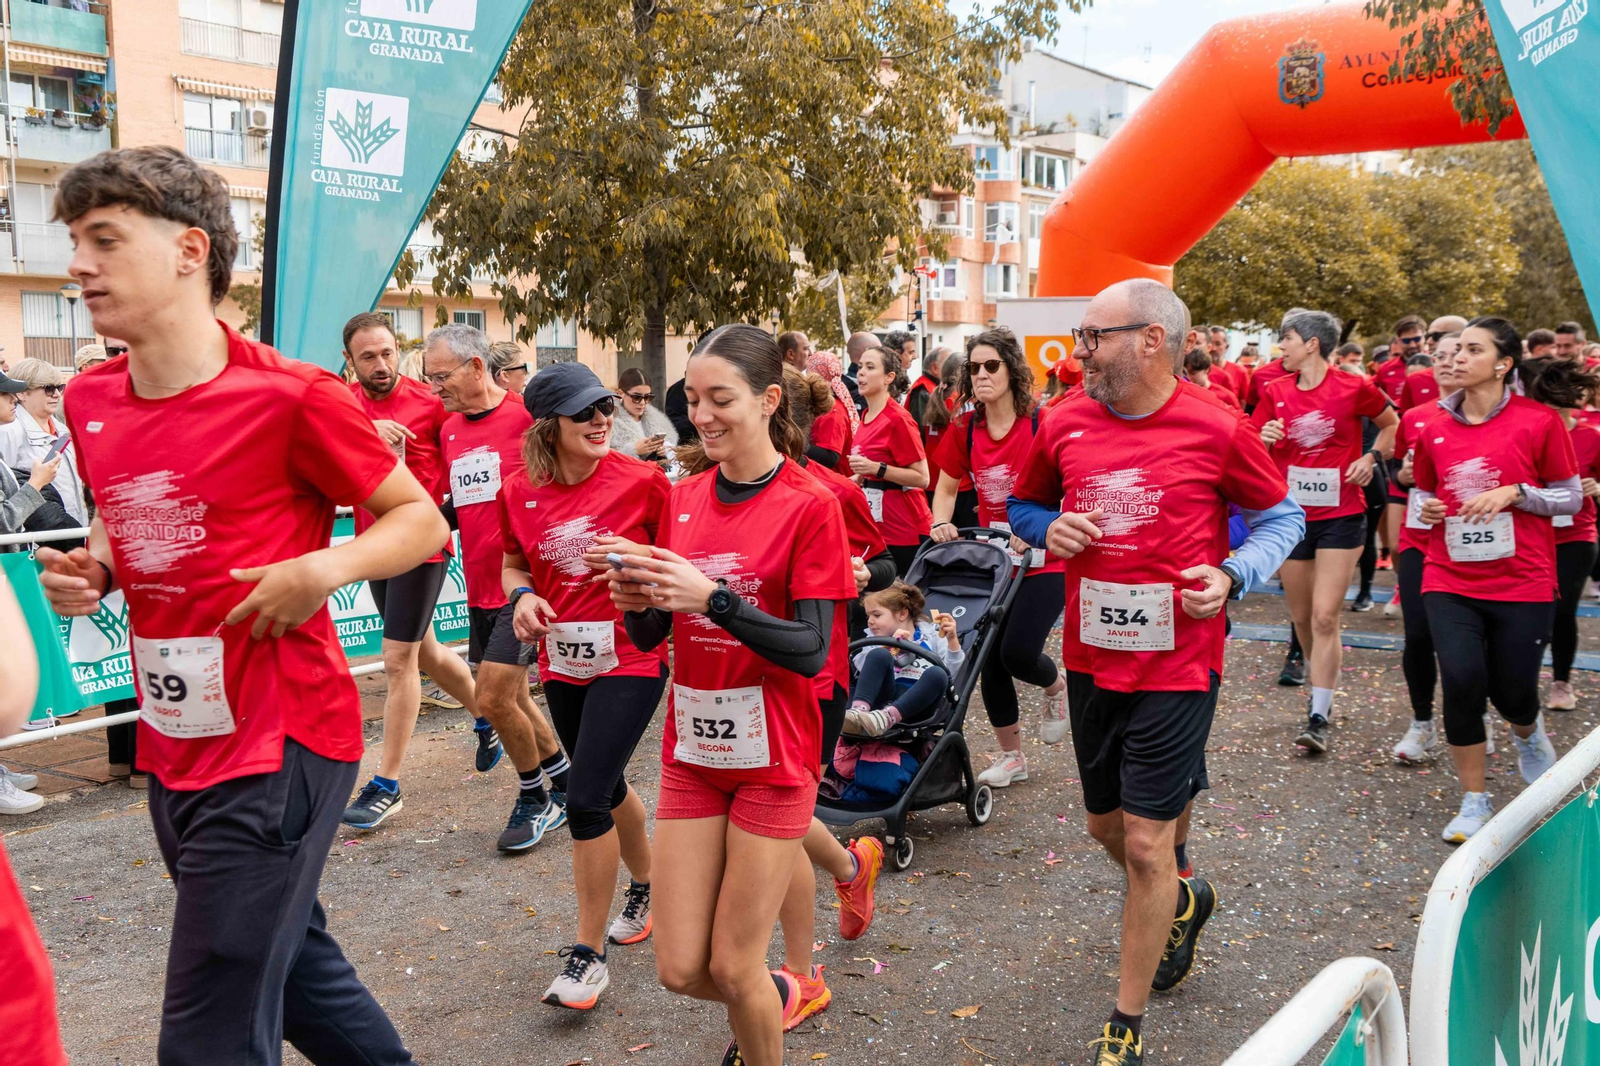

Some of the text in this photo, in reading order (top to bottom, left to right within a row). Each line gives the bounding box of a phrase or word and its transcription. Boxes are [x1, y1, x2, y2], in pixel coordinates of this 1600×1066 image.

[345, 19, 473, 53] CAJA RURAL
[369, 43, 444, 64] GRANADA
[311, 89, 325, 165] fundación
[311, 169, 403, 193] CAJA RURAL
[325, 186, 380, 202] GRANADA
[458, 470, 490, 487] 1043
[1297, 481, 1328, 492] 1410
[1076, 488, 1160, 502] kilómetros de
[181, 505, 204, 522] de
[1076, 501, 1160, 516] HUMANIDAD
[1462, 531, 1495, 544] 525
[541, 547, 588, 561] HUMANI
[740, 581, 759, 593] de
[433, 604, 454, 621] AJA
[1100, 606, 1149, 626] 534
[336, 617, 384, 636] RURAL
[440, 618, 470, 631] GRANA
[1107, 629, 1139, 637] JAVIER
[556, 641, 596, 659] 573
[565, 660, 593, 668] BEGOÑA
[81, 674, 134, 695] GRANAD
[692, 717, 737, 740] 532
[697, 742, 734, 752] BEGOÑA
